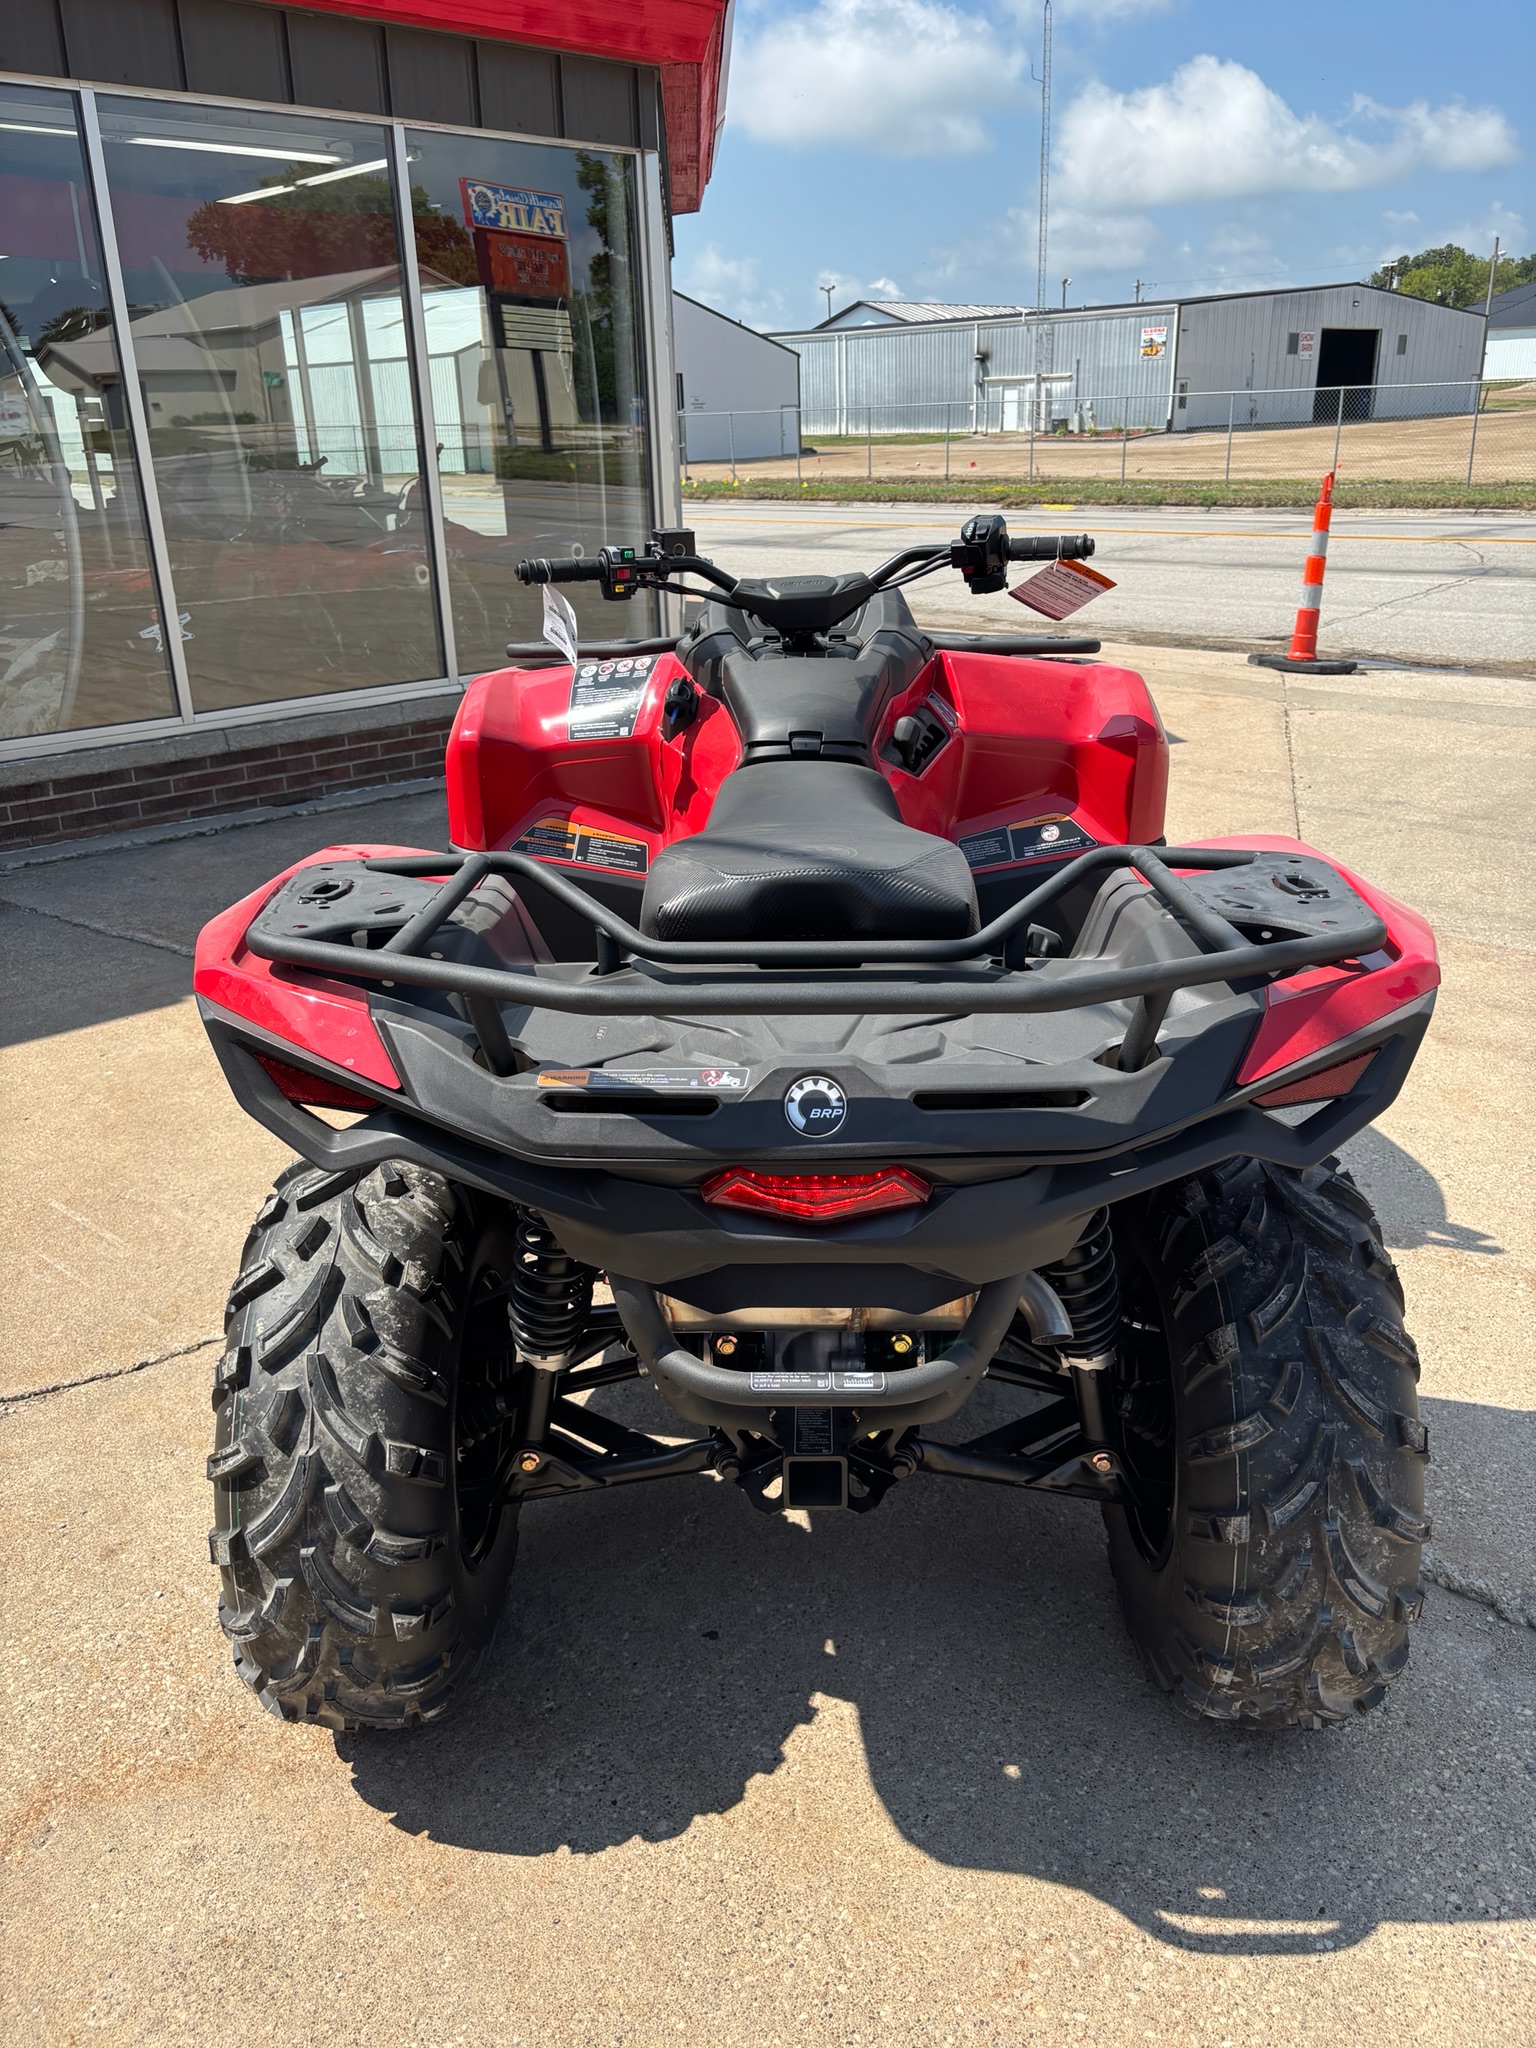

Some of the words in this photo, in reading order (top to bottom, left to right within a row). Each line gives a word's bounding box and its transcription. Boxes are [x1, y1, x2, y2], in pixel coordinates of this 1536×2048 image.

[1300, 333, 1314, 342] SHOW
[1301, 343, 1313, 352] BARN
[809, 1108, 844, 1119] BRP
